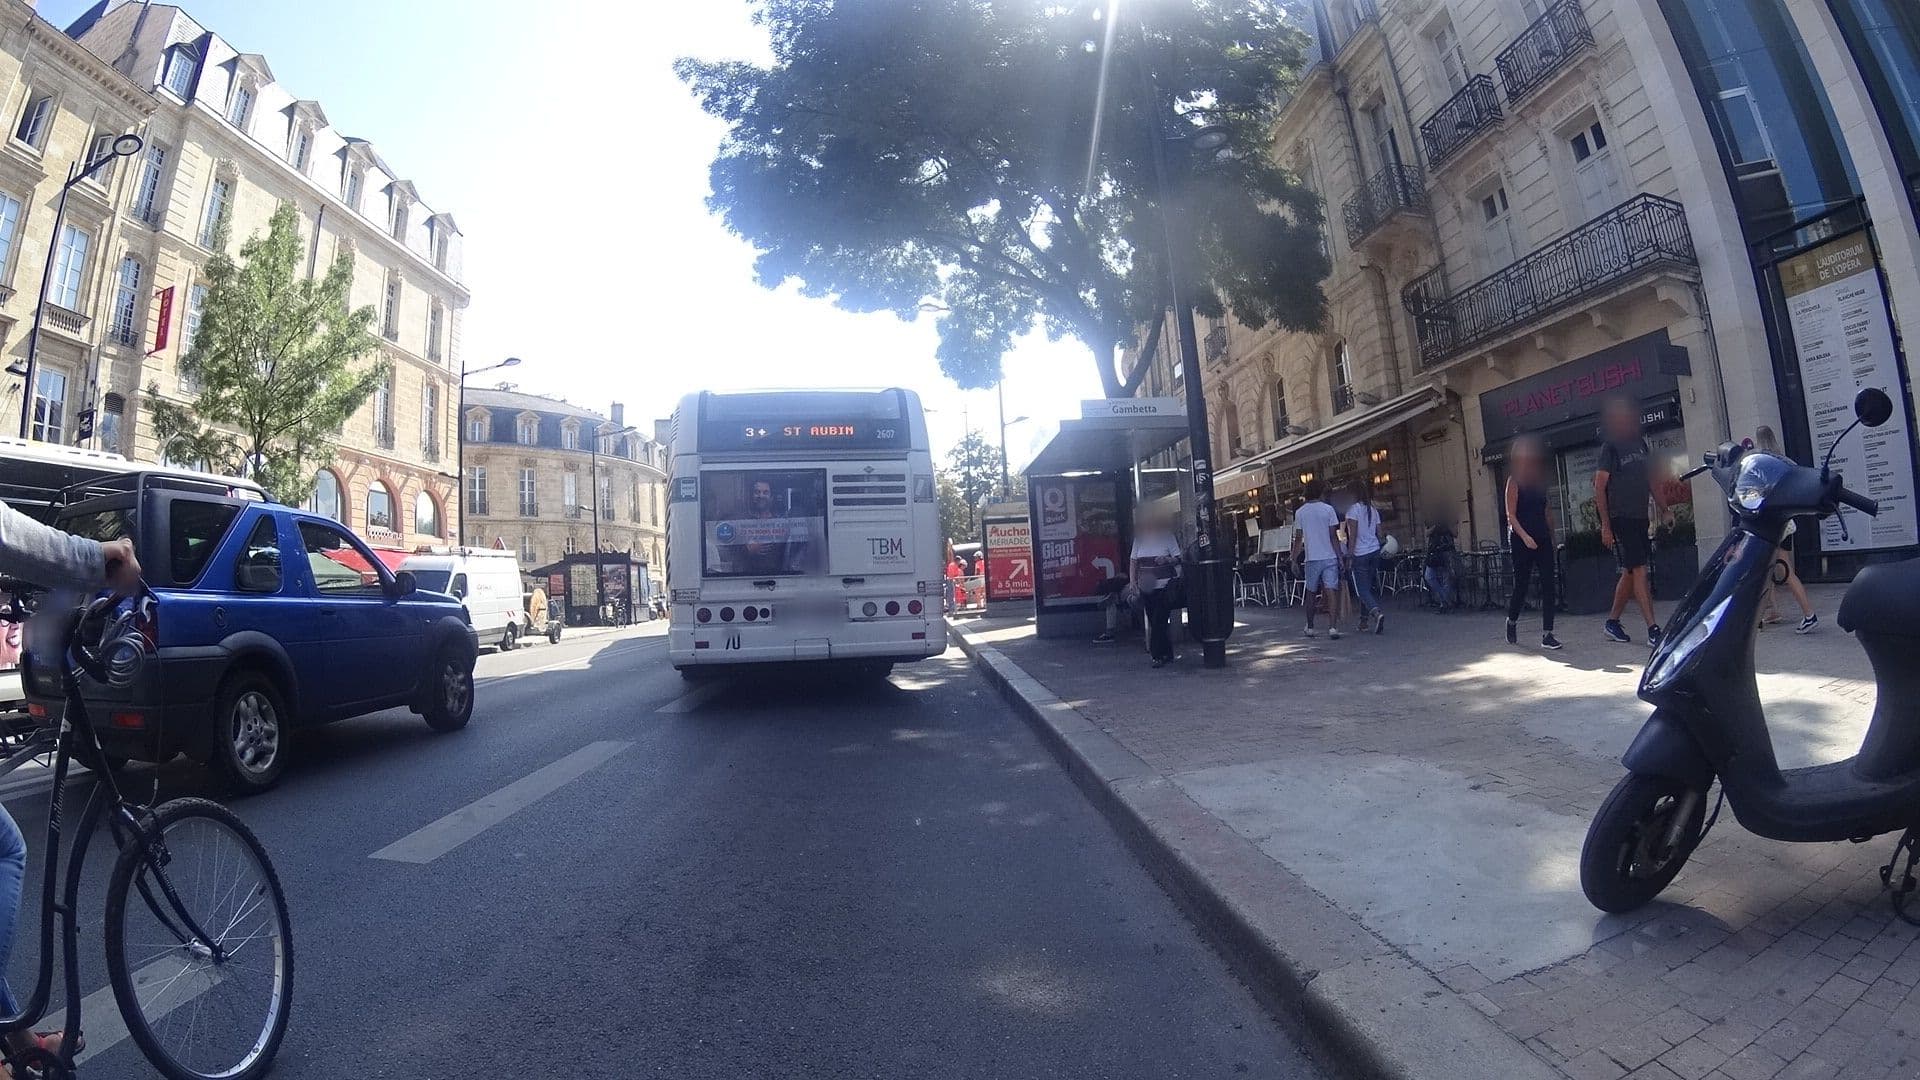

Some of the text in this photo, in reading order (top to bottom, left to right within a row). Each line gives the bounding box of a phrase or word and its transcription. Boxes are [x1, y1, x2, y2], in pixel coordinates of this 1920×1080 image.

[1816, 243, 1865, 269] L'AUDITORIUM
[1819, 269, 1831, 280] DE
[1503, 359, 1645, 417] PLANET SUSHI
[1112, 404, 1157, 414] Gambetta
[1640, 410, 1664, 424] USHI
[784, 426, 801, 437] ST
[810, 425, 854, 437] AUBIN
[876, 428, 896, 440] 2607
[866, 537, 906, 558] TBM
[1042, 540, 1075, 559] Giant
[997, 580, 1003, 588] à
[1005, 580, 1011, 588] 5
